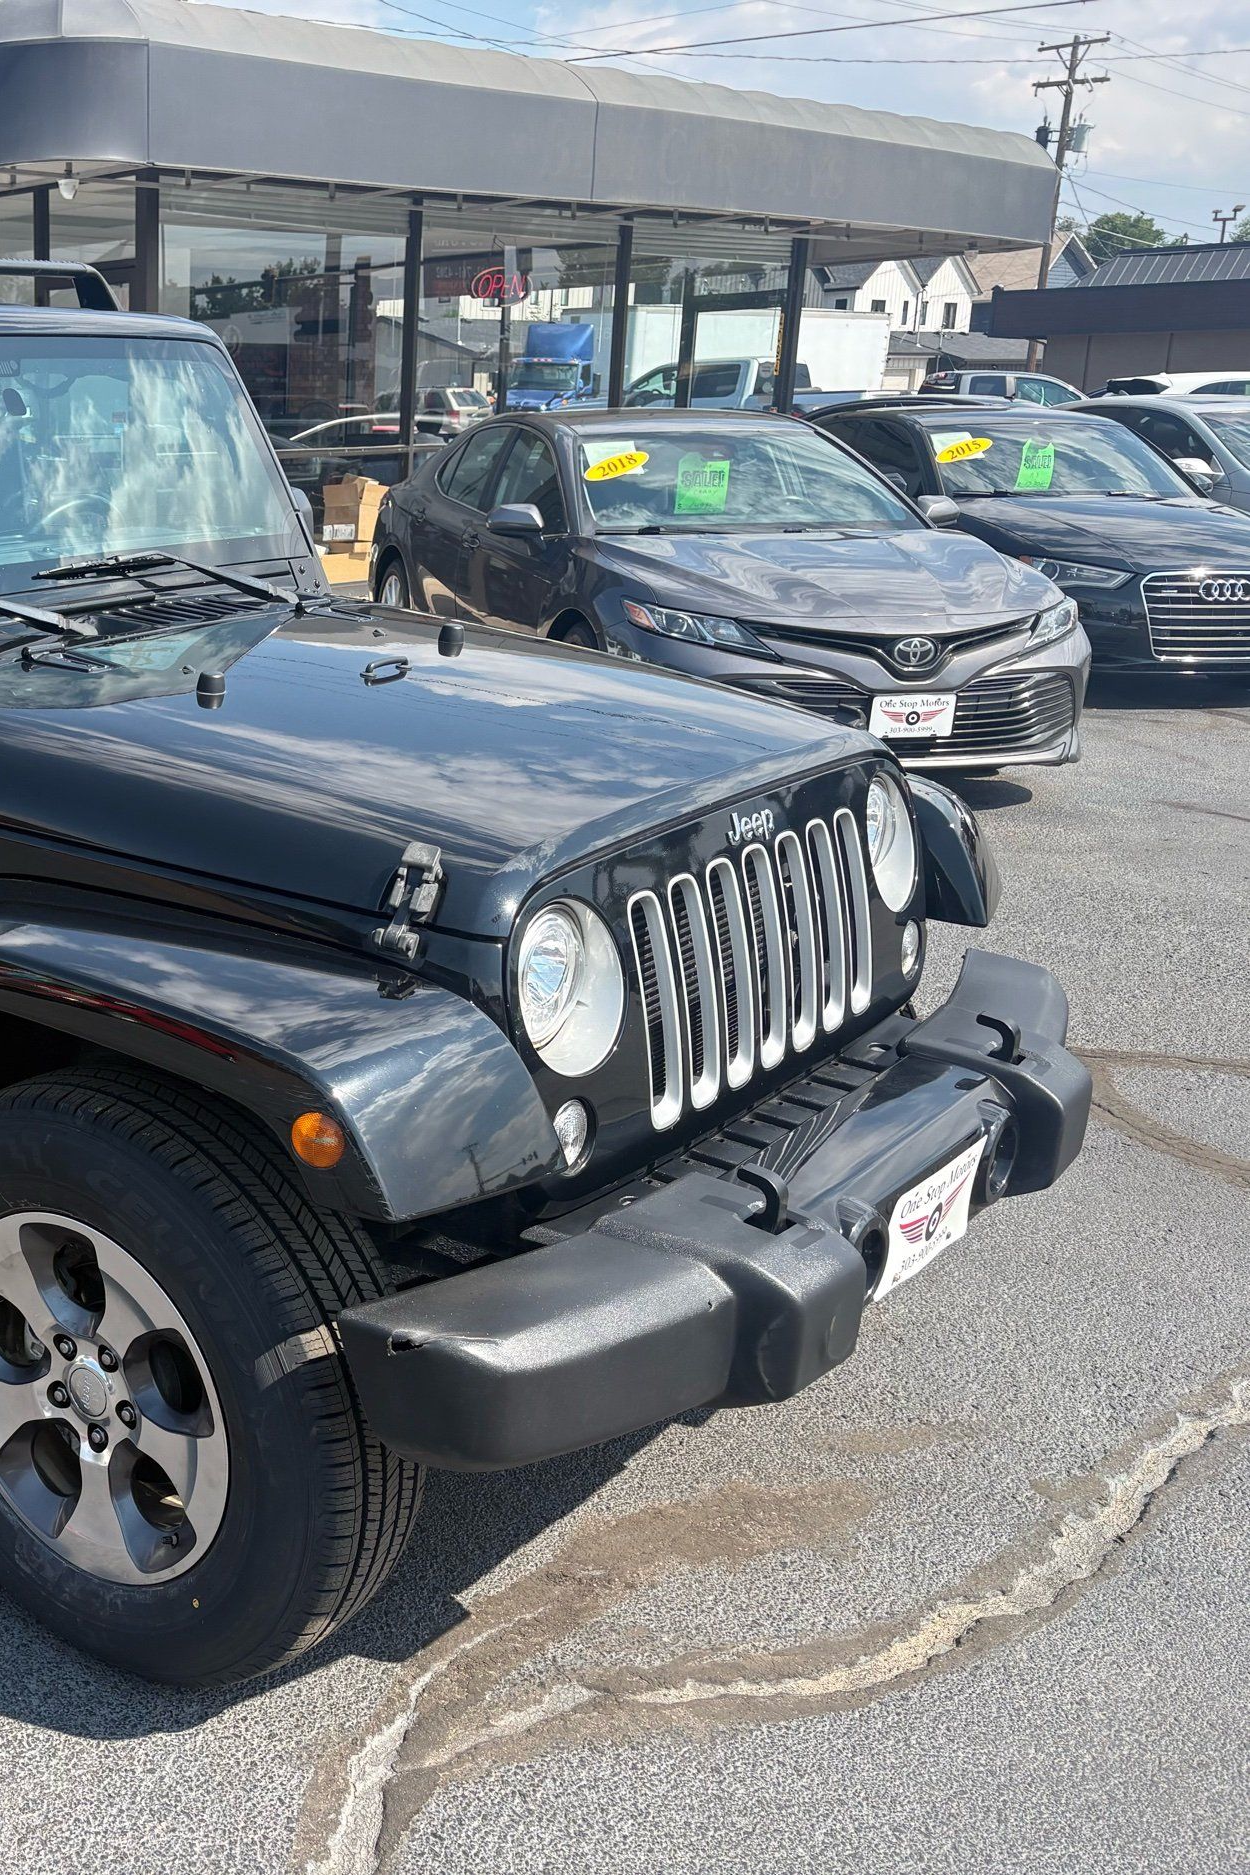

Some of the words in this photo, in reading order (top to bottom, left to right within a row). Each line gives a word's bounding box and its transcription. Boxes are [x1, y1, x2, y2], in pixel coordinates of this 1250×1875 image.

[478, 273, 526, 298] OPEN
[947, 440, 982, 460] 2015
[597, 454, 638, 477] 2018
[879, 699, 897, 709] One
[899, 699, 918, 709] Stop
[919, 698, 950, 708] Motors
[889, 726, 933, 734] 303-900-5999
[725, 808, 775, 846] Jeep
[900, 1195, 923, 1219] One
[923, 1181, 947, 1206] Stop
[947, 1157, 978, 1188] Motors
